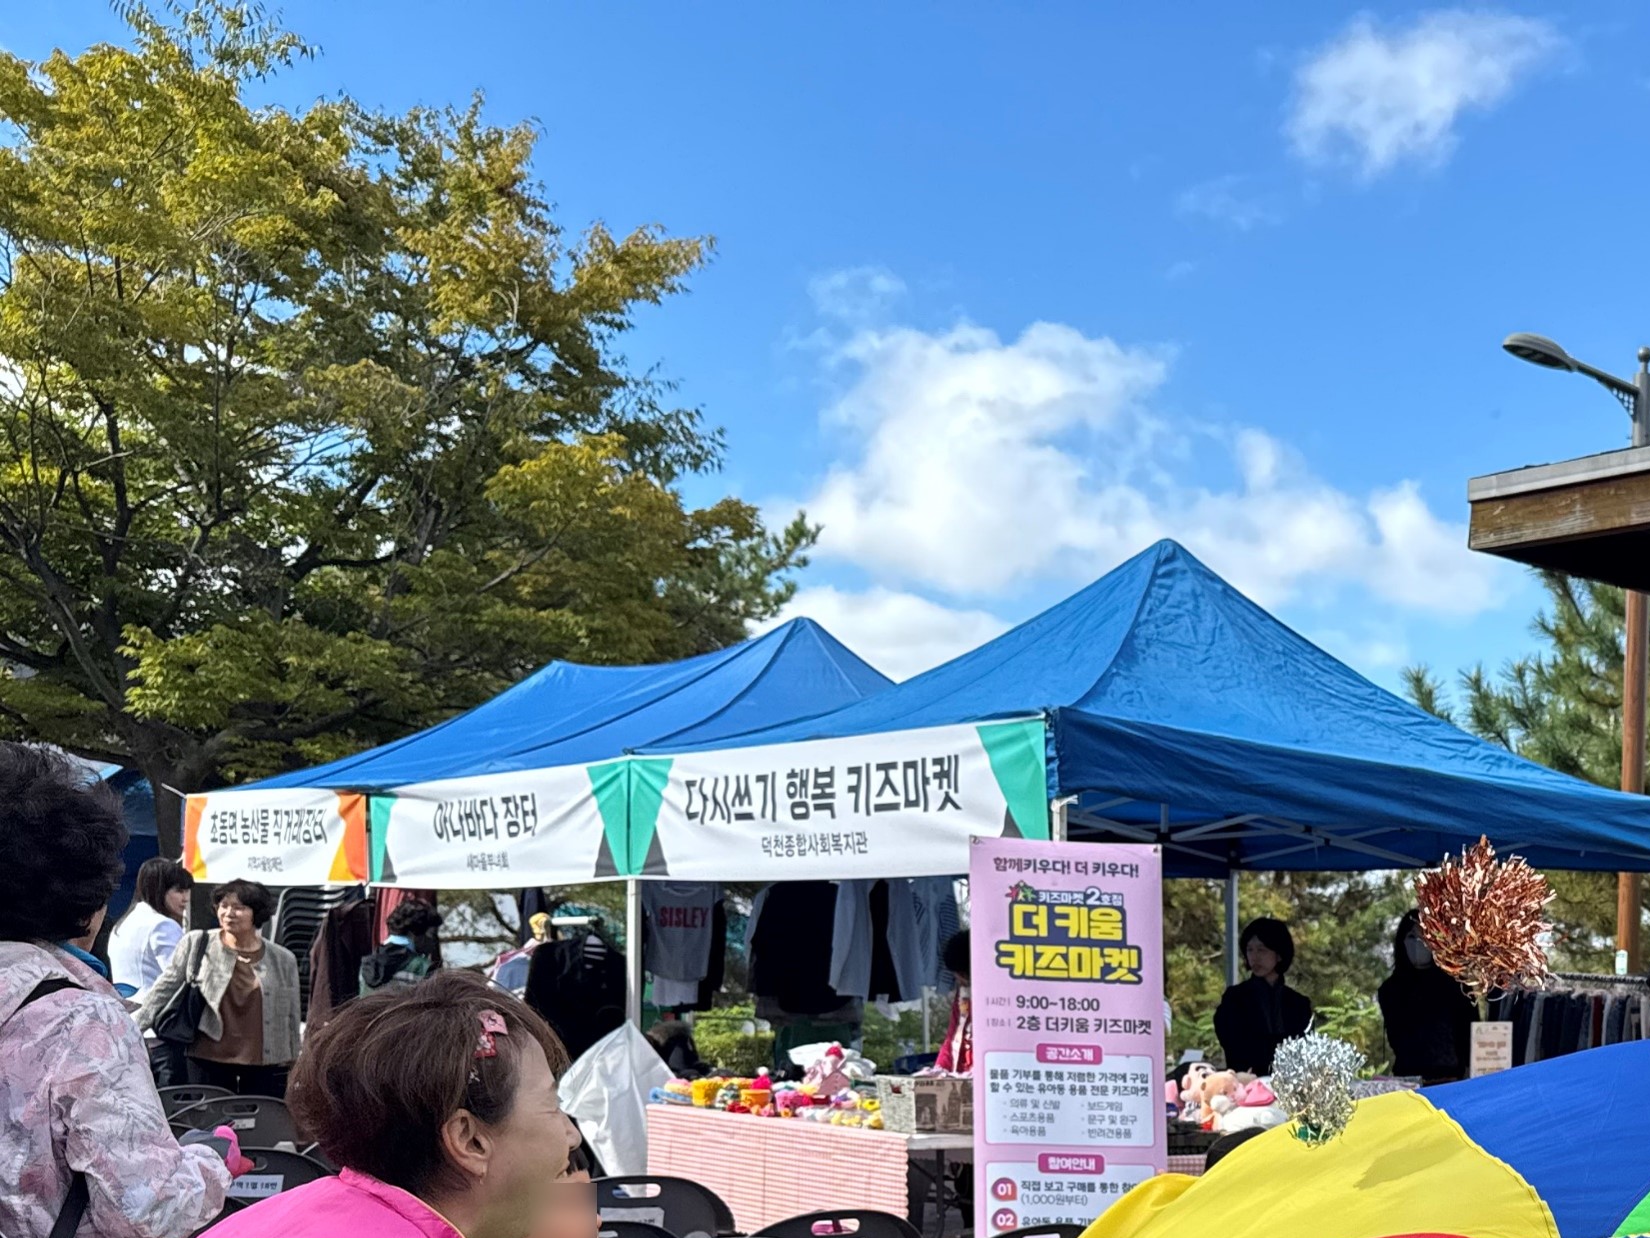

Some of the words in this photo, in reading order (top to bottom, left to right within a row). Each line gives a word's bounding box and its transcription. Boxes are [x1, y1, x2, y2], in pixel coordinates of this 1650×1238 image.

[684, 770, 777, 825] 다시쓰기
[786, 766, 837, 821] 행복
[847, 754, 962, 816] 키즈마켓
[210, 810, 239, 844] 초동면
[241, 809, 270, 844] 농산물
[273, 808, 328, 844] 직거래장터
[433, 797, 499, 842] 아나바다
[502, 792, 538, 838] 장터
[761, 832, 868, 858] 덕천종합사회복지관
[993, 857, 1070, 875] 함께키우다!
[1075, 861, 1088, 875] 더
[1092, 862, 1139, 878] 키우다!
[1038, 891, 1084, 905] 키즈마켓
[1086, 888, 1122, 907] 2호점
[660, 906, 709, 928] SISLEY
[1013, 904, 1048, 938] 더
[1054, 906, 1123, 941] 키움
[999, 943, 1140, 982] 키즈마켓
[1016, 995, 1100, 1012] 9:00~18:00
[1016, 1015, 1041, 1032] 2층
[1046, 1017, 1090, 1034] 더키움
[1094, 1018, 1152, 1036] 키즈마켓
[1045, 1046, 1094, 1061] 공간소개
[1012, 1069, 1042, 1081] 기부를
[1098, 1072, 1127, 1083] 가격에
[1130, 1073, 1149, 1084] 구입
[1002, 1082, 1013, 1093] 수
[1015, 1082, 1035, 1094] 있는
[1038, 1083, 1065, 1095] 유아동
[1090, 1085, 1109, 1096] 전문
[1112, 1085, 1149, 1097] 키즈마켓
[997, 1183, 1012, 1196] 01
[1021, 1180, 1041, 1192] 직접
[1044, 1181, 1065, 1192] 보고
[1067, 1182, 1096, 1193] 구매를
[1020, 1194, 1088, 1206] (1,000원부터)
[996, 1214, 1014, 1226] 02
